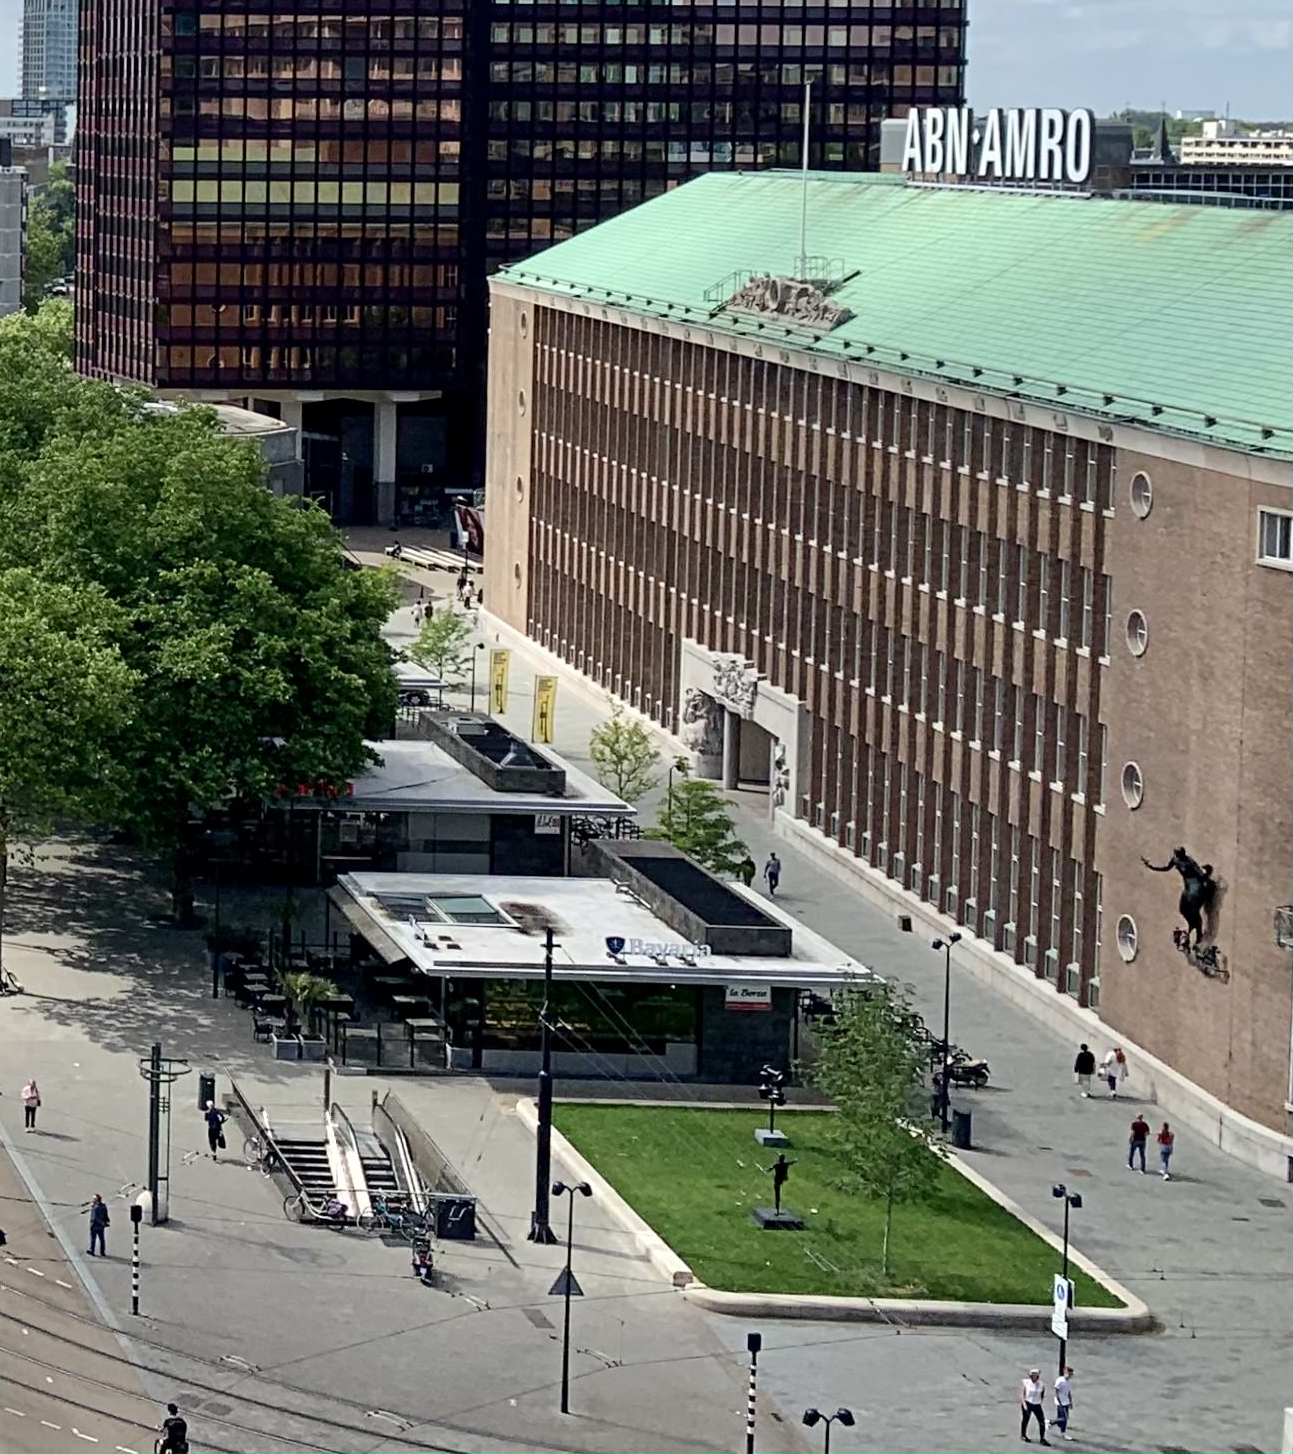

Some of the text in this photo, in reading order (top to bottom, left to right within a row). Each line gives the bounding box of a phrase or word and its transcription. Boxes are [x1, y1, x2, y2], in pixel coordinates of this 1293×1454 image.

[902, 107, 1094, 183] ABN AMRO
[629, 938, 712, 959] Bavaria
